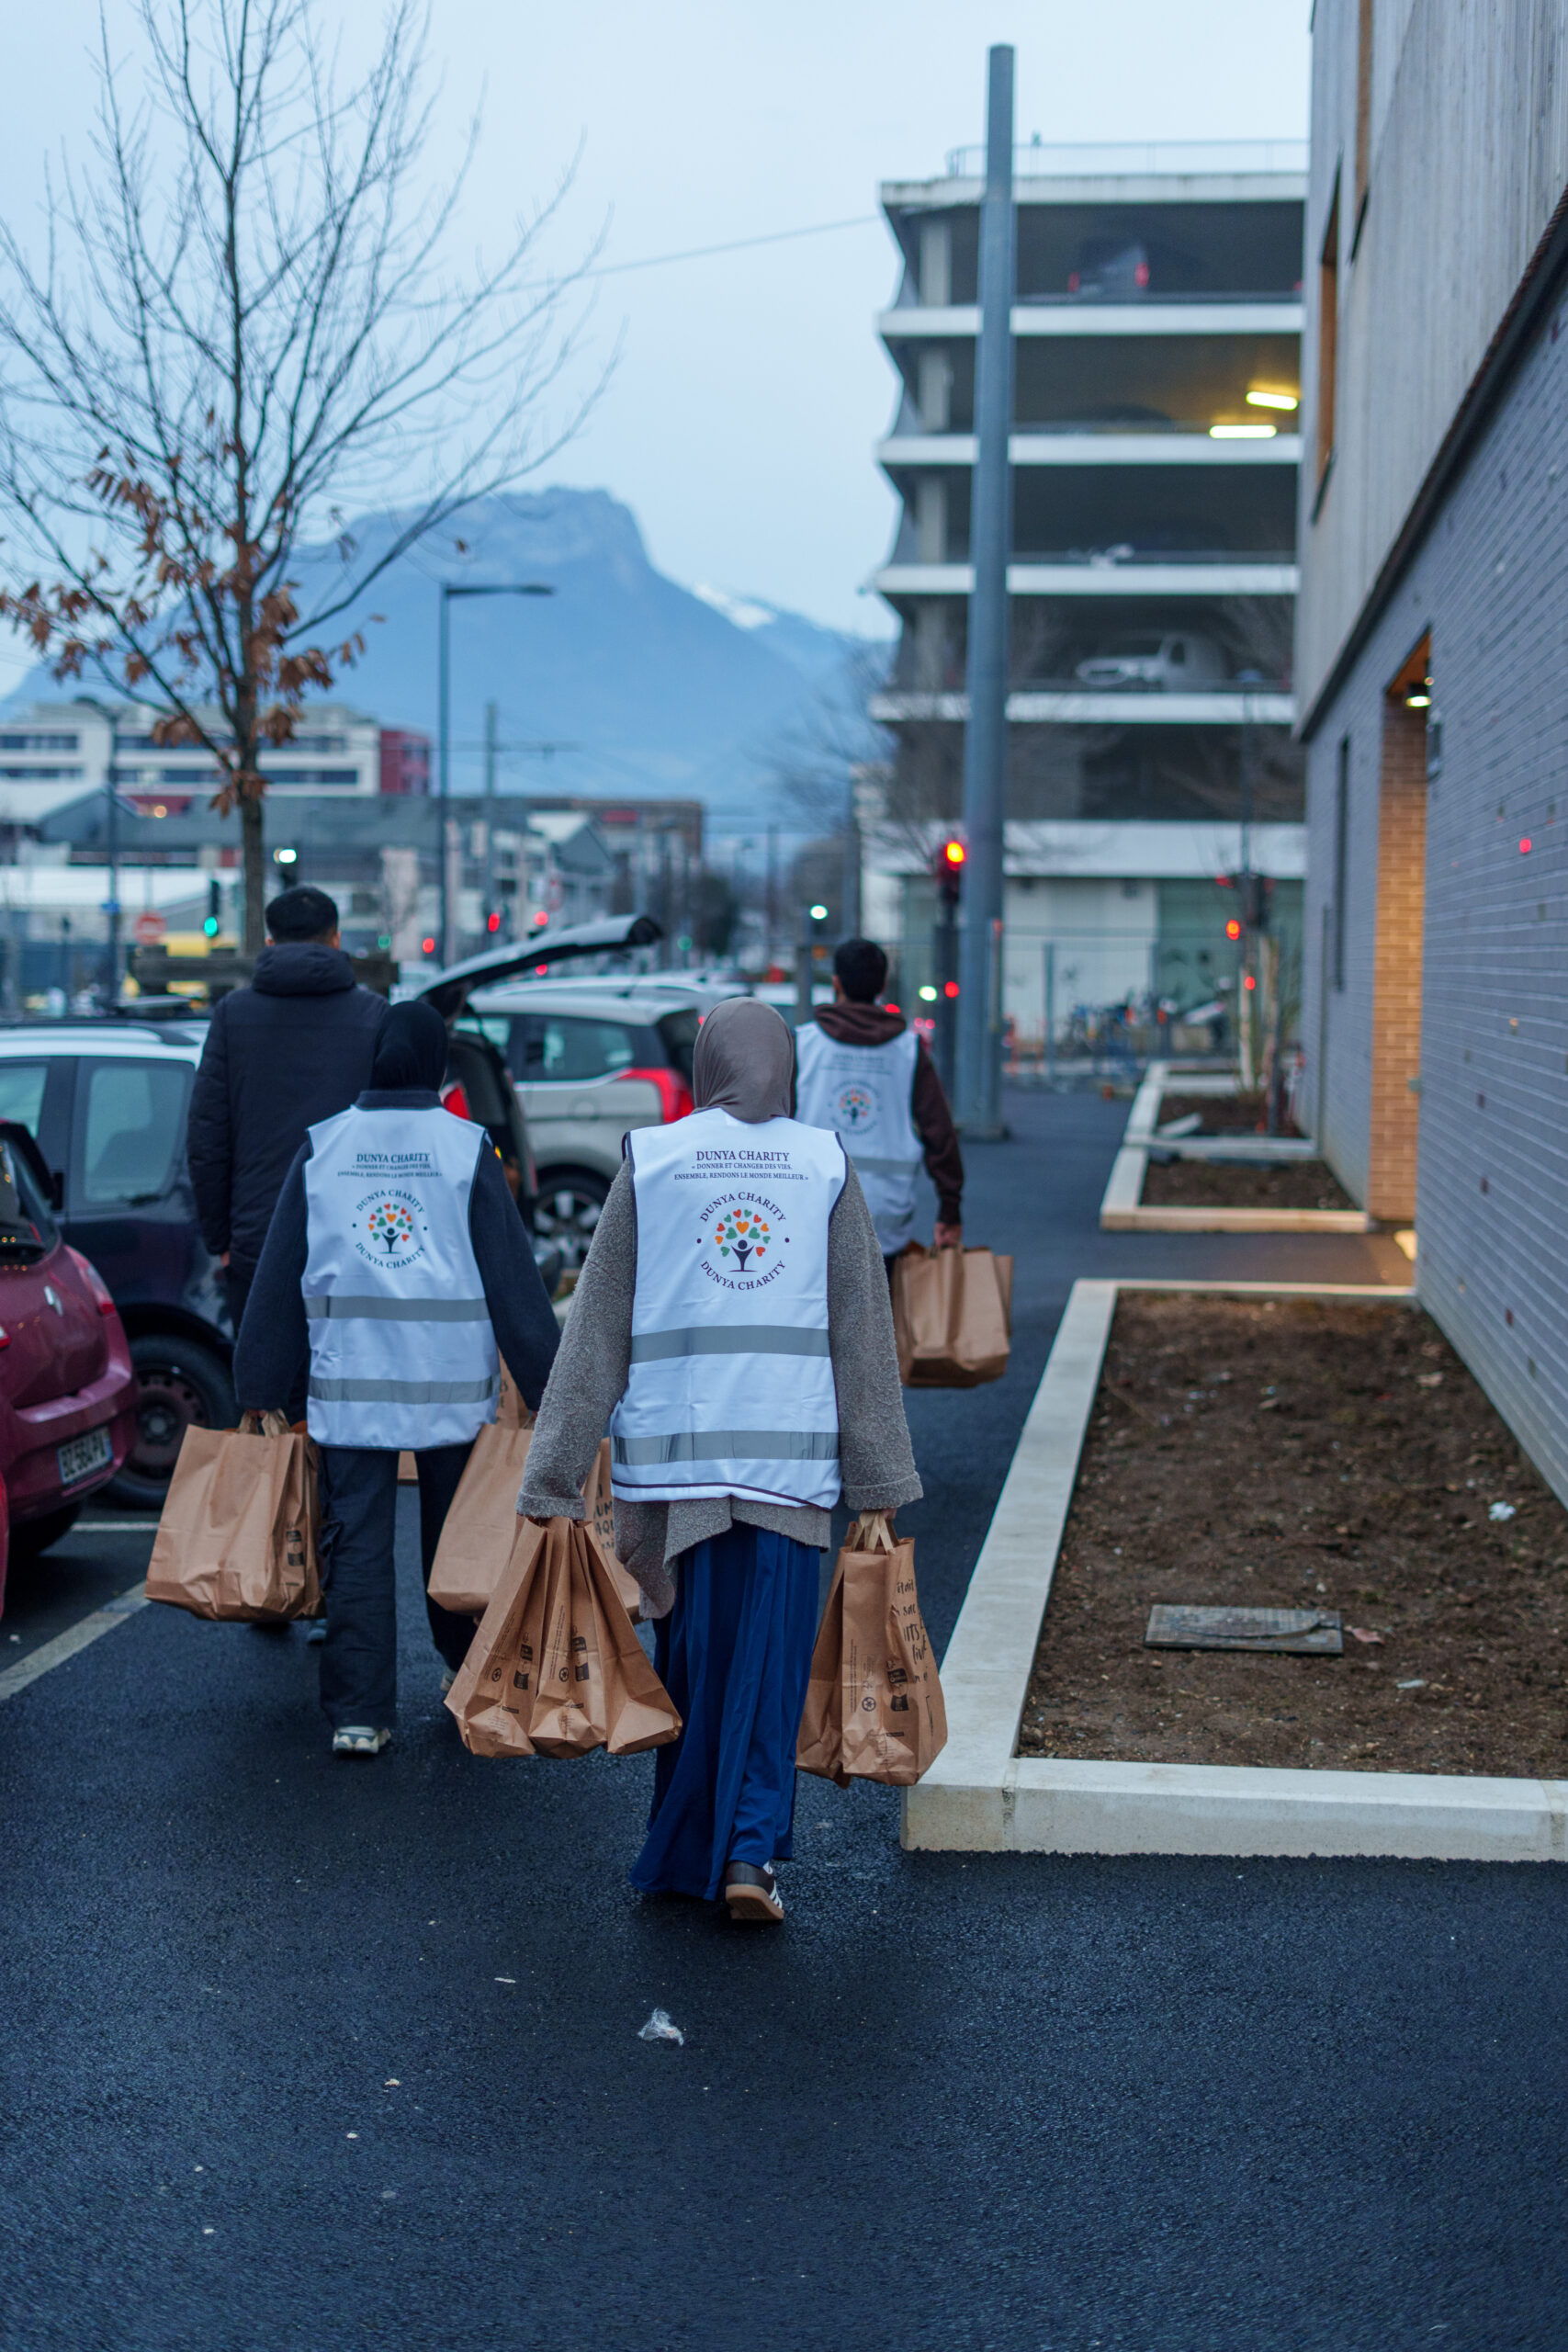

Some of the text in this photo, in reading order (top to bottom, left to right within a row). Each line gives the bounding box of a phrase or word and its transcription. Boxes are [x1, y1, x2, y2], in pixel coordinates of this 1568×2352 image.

[356, 1152, 431, 1163] DUNYA CHARITY
[696, 1150, 790, 1161] DUNYA CHARITY
[674, 1172, 708, 1181] ENSEMBLE,
[773, 1172, 804, 1181] MEILLEUR
[355, 1189, 424, 1213] DUNYA CHARITY
[700, 1192, 786, 1223] DUNYA CHARITY
[355, 1242, 425, 1269] DUNYA CHARITY
[700, 1260, 785, 1291] DUNYA CHARITY
